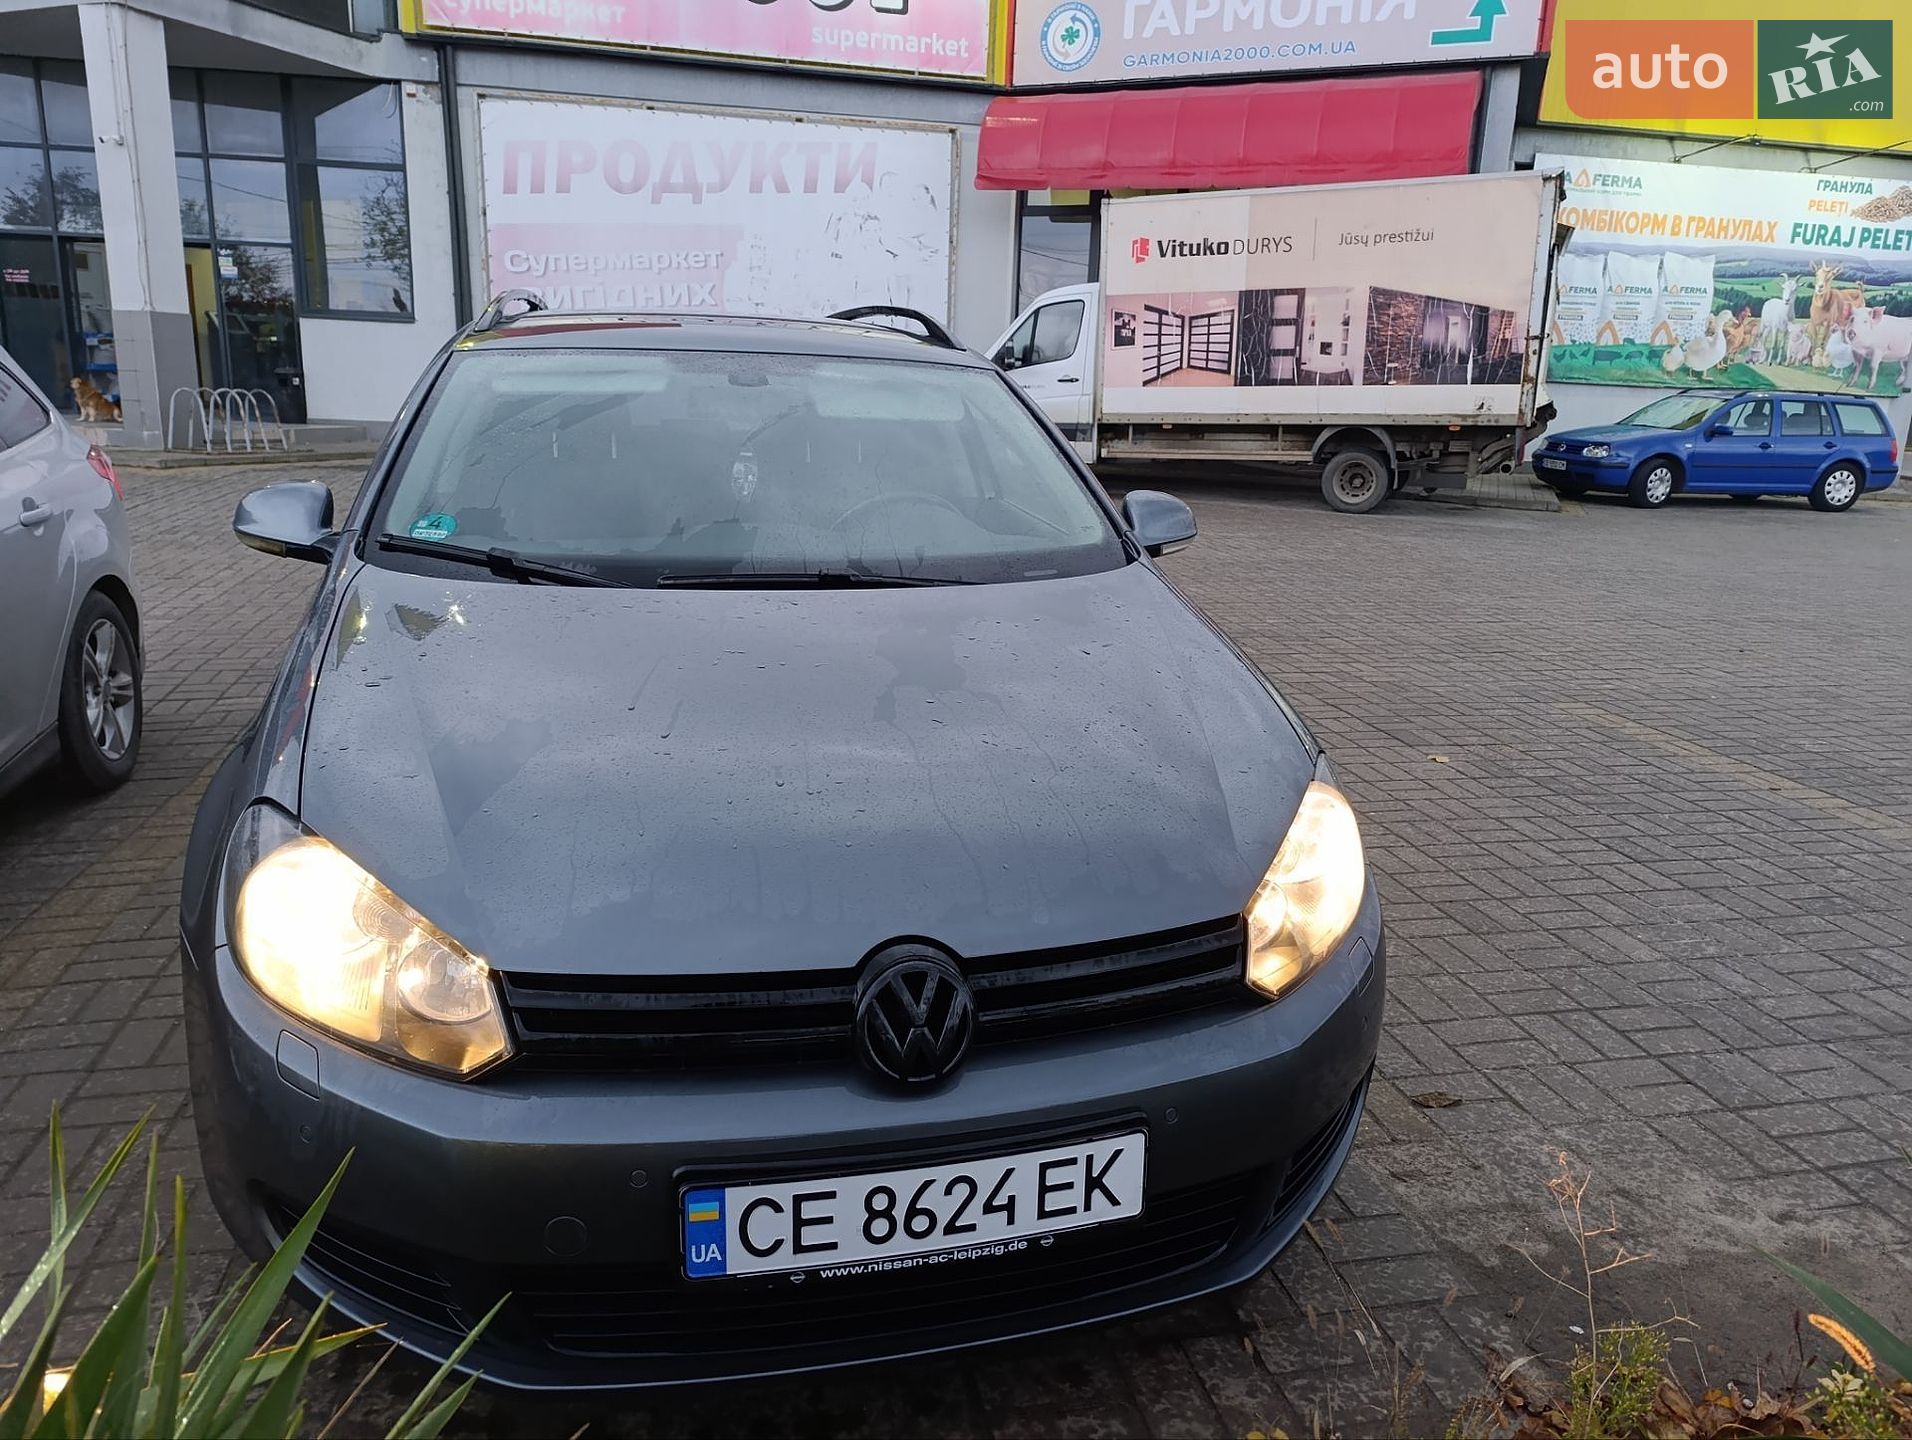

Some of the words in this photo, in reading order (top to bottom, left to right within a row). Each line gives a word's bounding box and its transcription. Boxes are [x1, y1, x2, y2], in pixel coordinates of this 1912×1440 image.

[811, 25, 970, 58] supermarket
[1123, 40, 1357, 68] GARMONIA2000.COM.UA
[502, 138, 879, 206] ПРОДУКТИ
[1592, 173, 1643, 190] FERMA
[1816, 179, 1874, 195] ГРАНУЛА
[1338, 230, 1369, 248] Jūsų
[1373, 227, 1435, 246] prestižui
[1670, 212, 1683, 238] В
[1685, 215, 1779, 243] ГРАНУЛАХ
[1790, 222, 1857, 248] FURAJ
[503, 249, 725, 277] Супермаркет
[1624, 286, 1653, 295] FERMA
[1679, 286, 1708, 295] FERMA
[738, 1190, 839, 1258] CE
[862, 1167, 1016, 1246] 8624
[1036, 1147, 1126, 1221] EK
[691, 1243, 722, 1264] UA
[819, 1239, 1028, 1279] www.nissan-ac-leipzig.de
